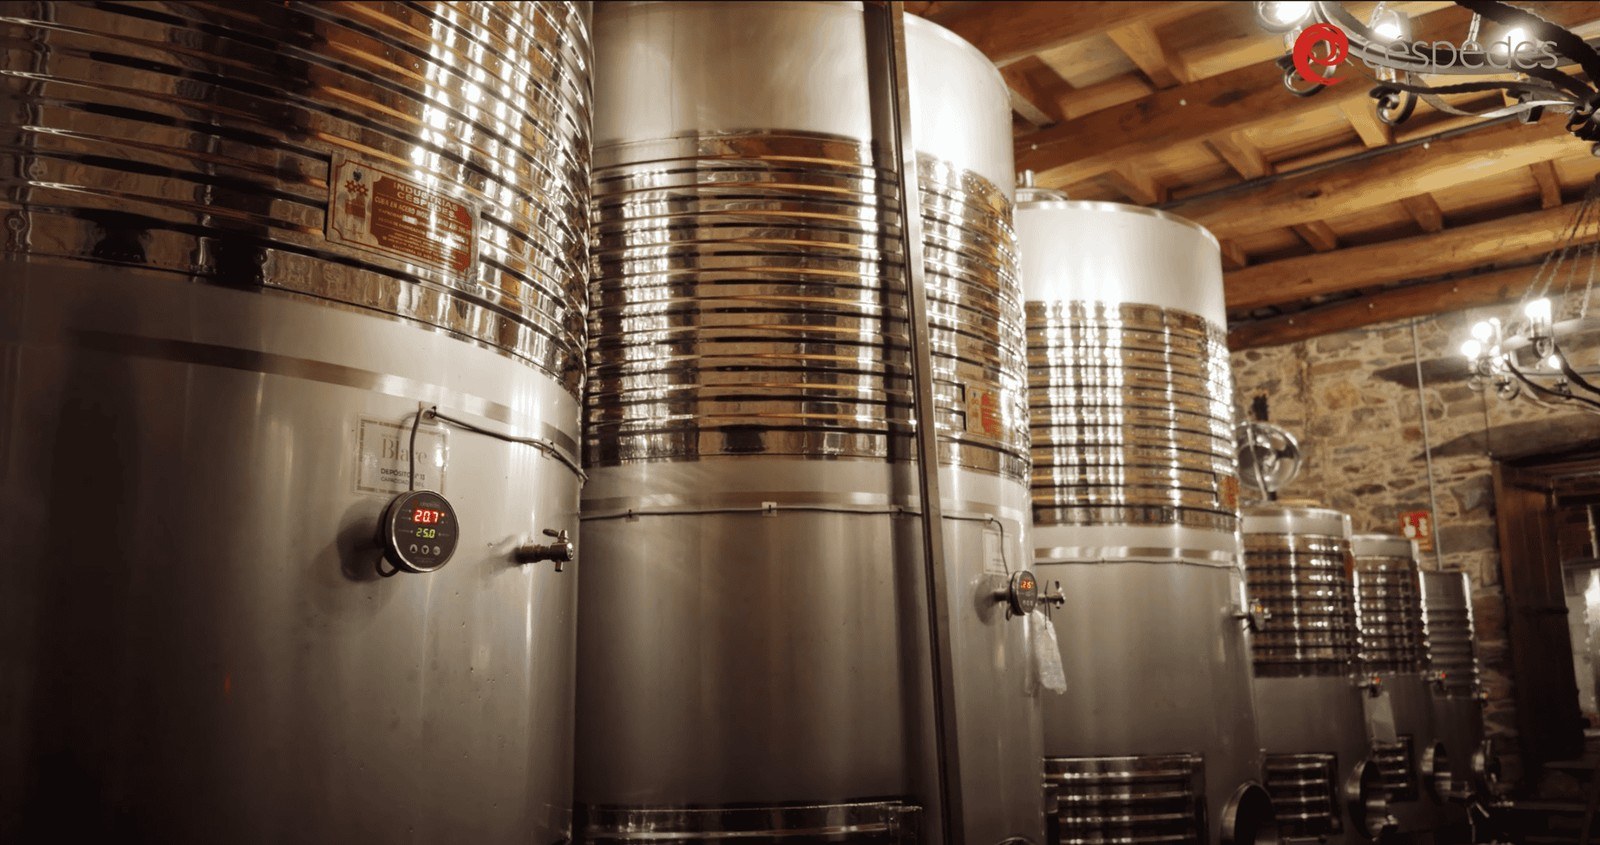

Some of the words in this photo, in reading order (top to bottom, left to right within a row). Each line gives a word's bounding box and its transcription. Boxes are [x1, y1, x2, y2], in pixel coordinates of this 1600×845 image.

[394, 181, 458, 211] INDUSTRIAS
[414, 509, 439, 524] 20.7
[415, 527, 436, 539] 25.0
